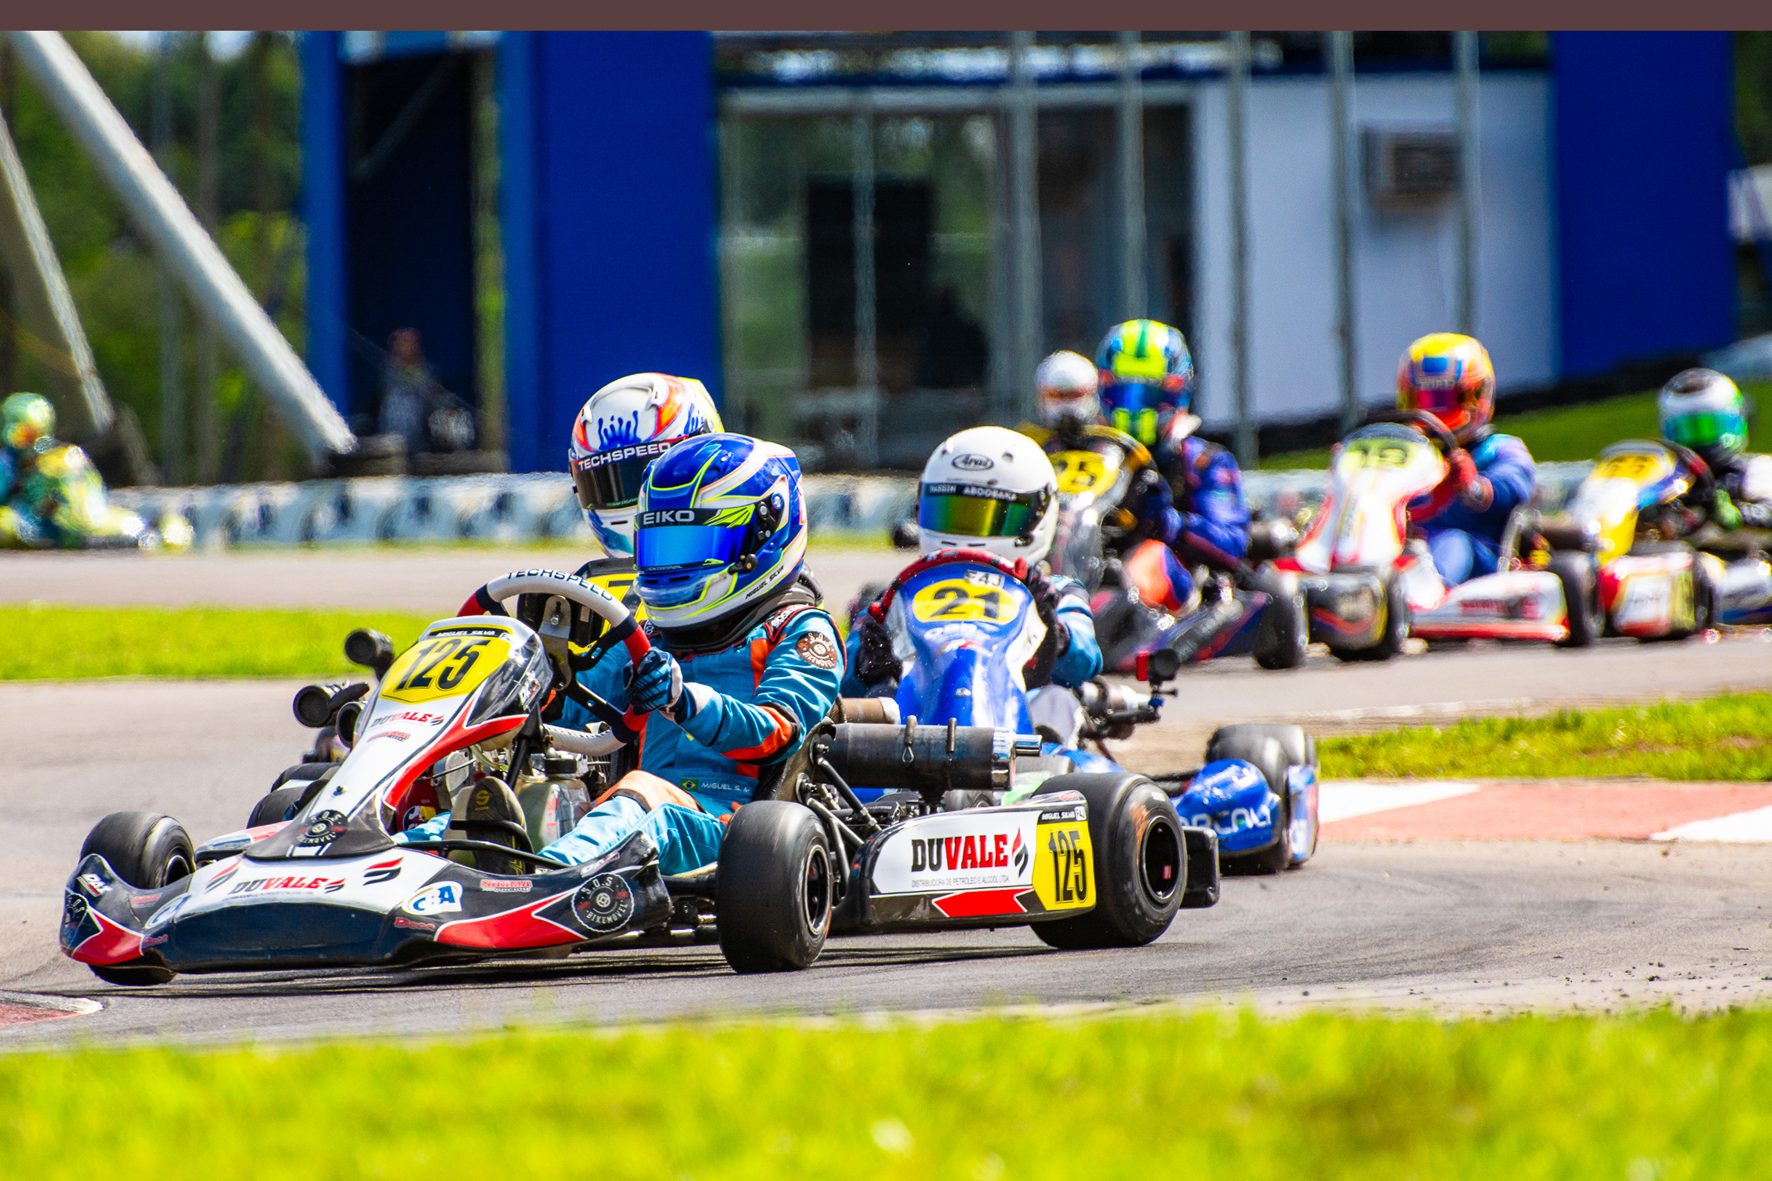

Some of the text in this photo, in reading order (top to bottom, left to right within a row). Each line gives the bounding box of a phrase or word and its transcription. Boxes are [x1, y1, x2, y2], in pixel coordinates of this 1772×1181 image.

[578, 442, 672, 472] TECHSPEED
[643, 510, 696, 526] EIKO
[507, 567, 614, 602] TECHSPEED
[929, 586, 1001, 619] 21
[393, 637, 492, 693] 125
[369, 710, 434, 729] DUVALE
[910, 833, 1009, 873] DUVALE
[1048, 830, 1088, 905] 125
[227, 876, 330, 896] DUVALE
